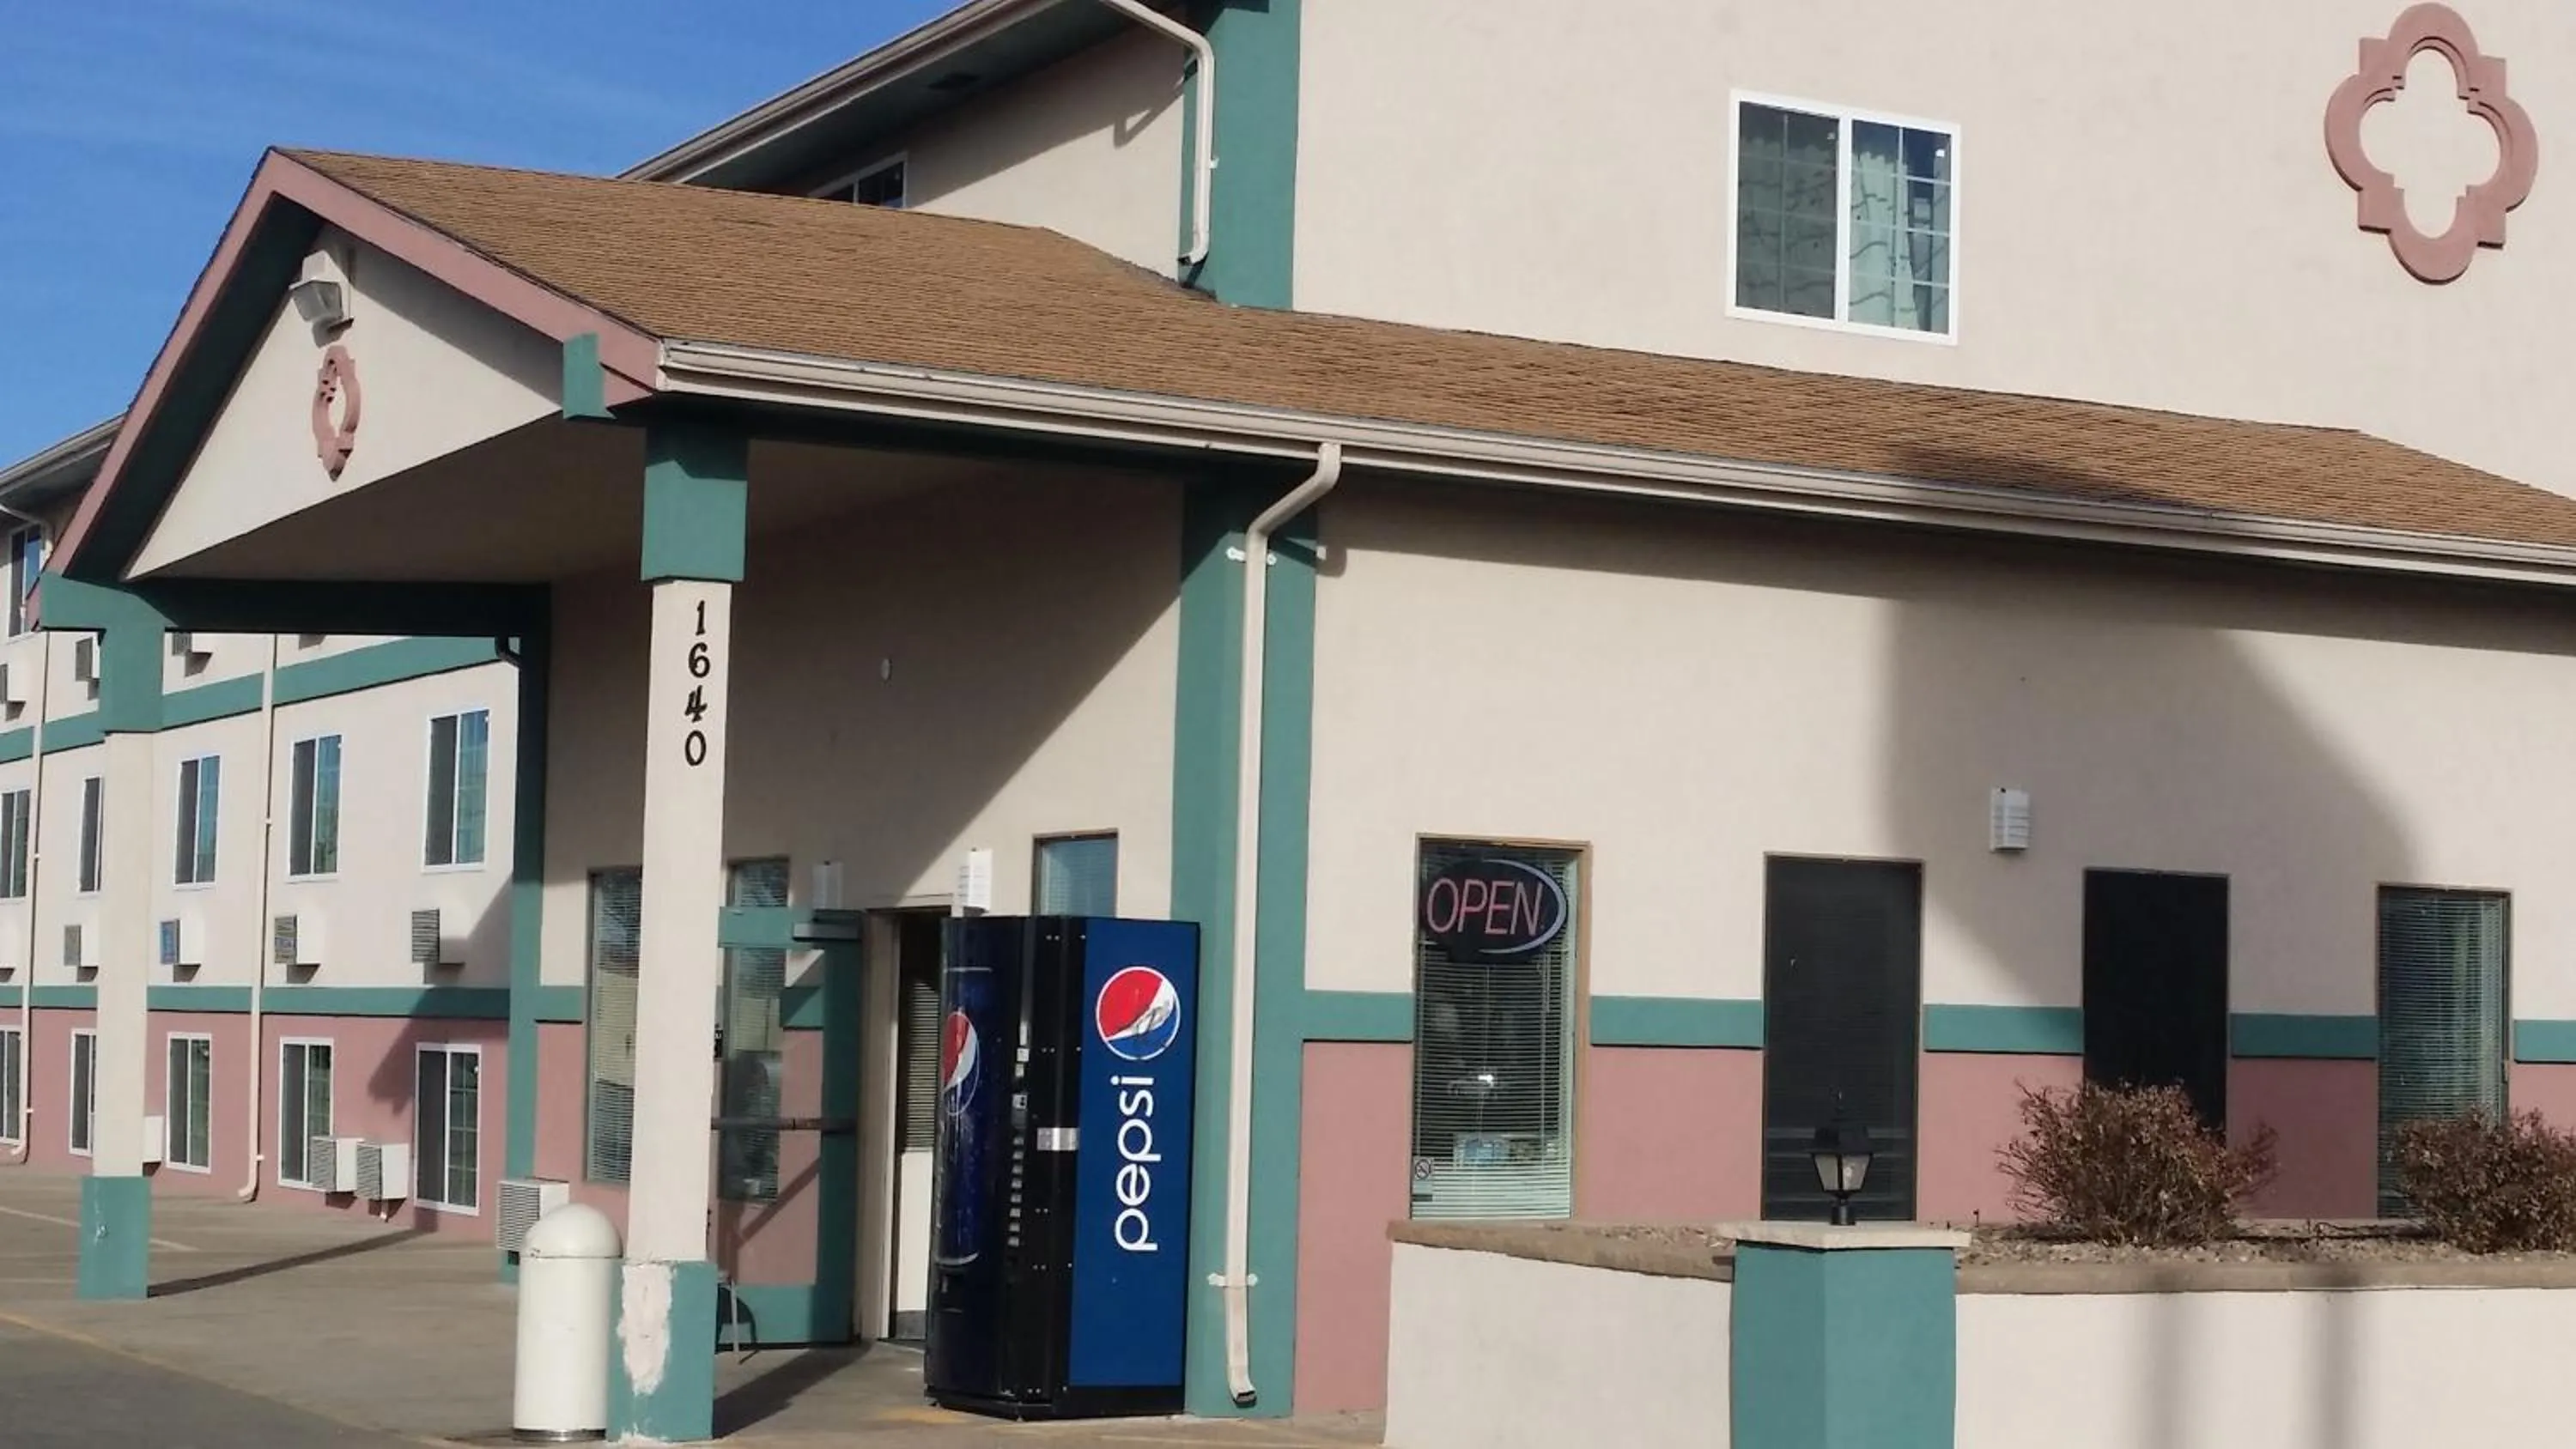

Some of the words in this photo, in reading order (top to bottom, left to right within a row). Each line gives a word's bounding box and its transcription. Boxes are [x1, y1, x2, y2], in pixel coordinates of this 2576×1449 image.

[684, 600, 711, 767] 1640
[1427, 877, 1544, 936] OPEN
[1110, 1076, 1162, 1252] pepsi
